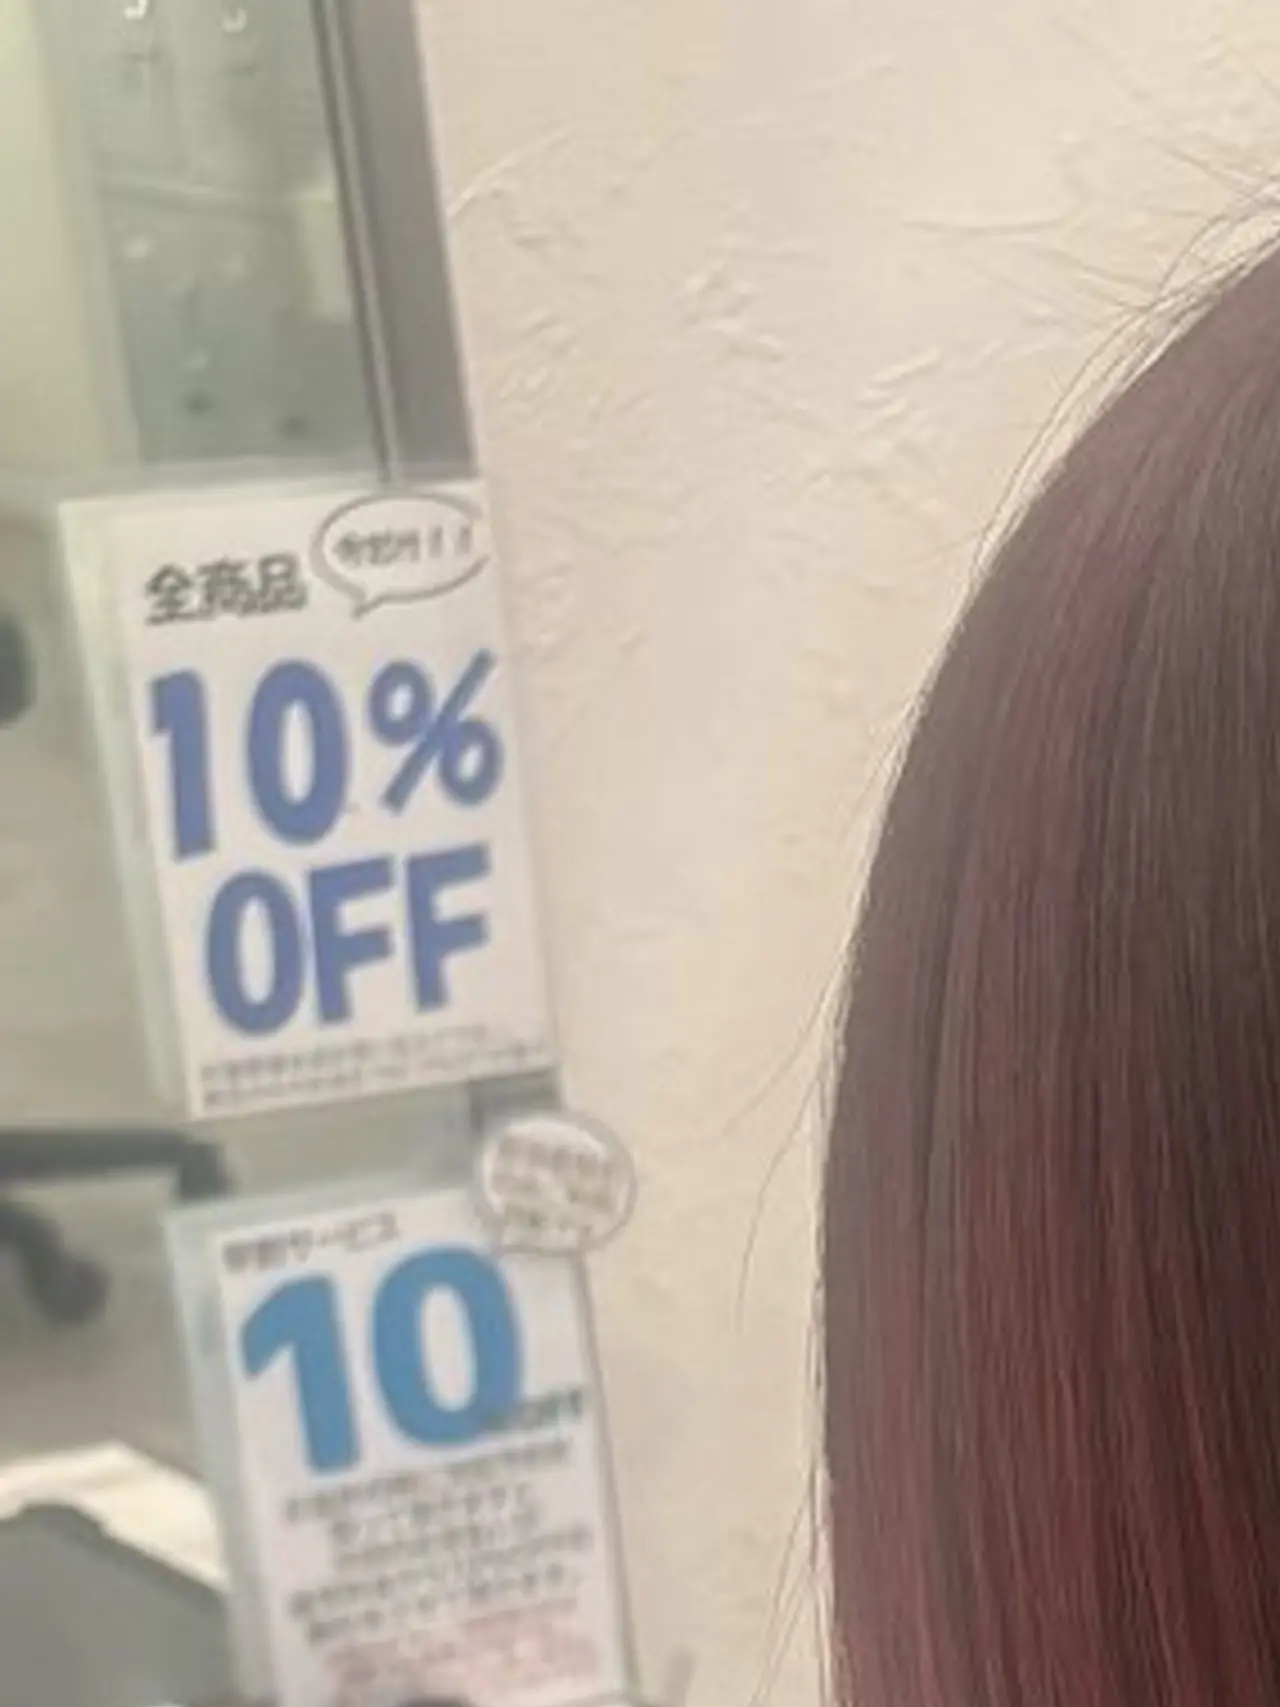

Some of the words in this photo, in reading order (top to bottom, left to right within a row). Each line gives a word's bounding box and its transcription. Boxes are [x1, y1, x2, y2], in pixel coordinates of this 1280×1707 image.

[144, 551, 308, 626] 全商品
[149, 650, 503, 862] 10%
[204, 842, 490, 1036] OFF
[240, 1246, 526, 1475] 10
